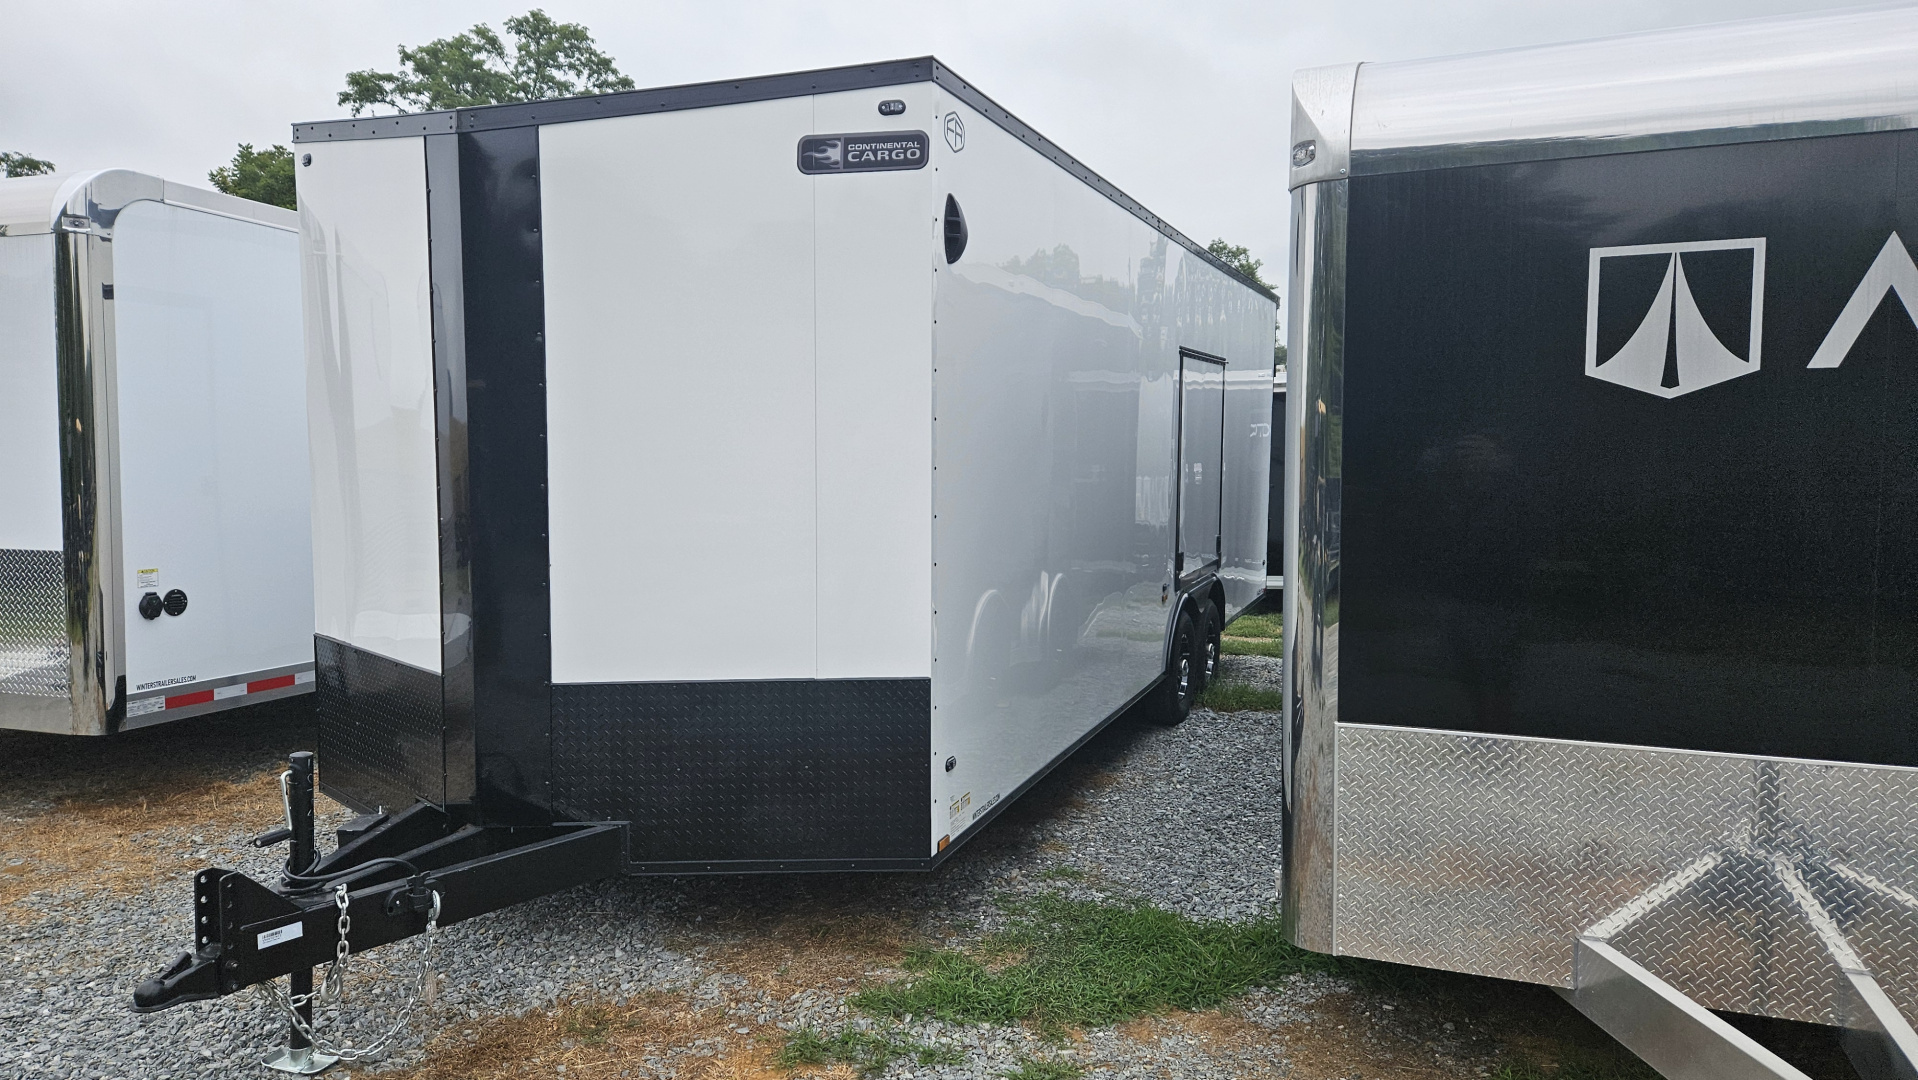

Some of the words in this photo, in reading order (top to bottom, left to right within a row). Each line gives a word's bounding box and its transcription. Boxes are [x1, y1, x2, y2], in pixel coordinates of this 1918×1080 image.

[848, 141, 920, 150] CONTINENTAL
[847, 149, 921, 162] CARGO
[136, 675, 197, 691] WINTERSTRAILERSALES.COM
